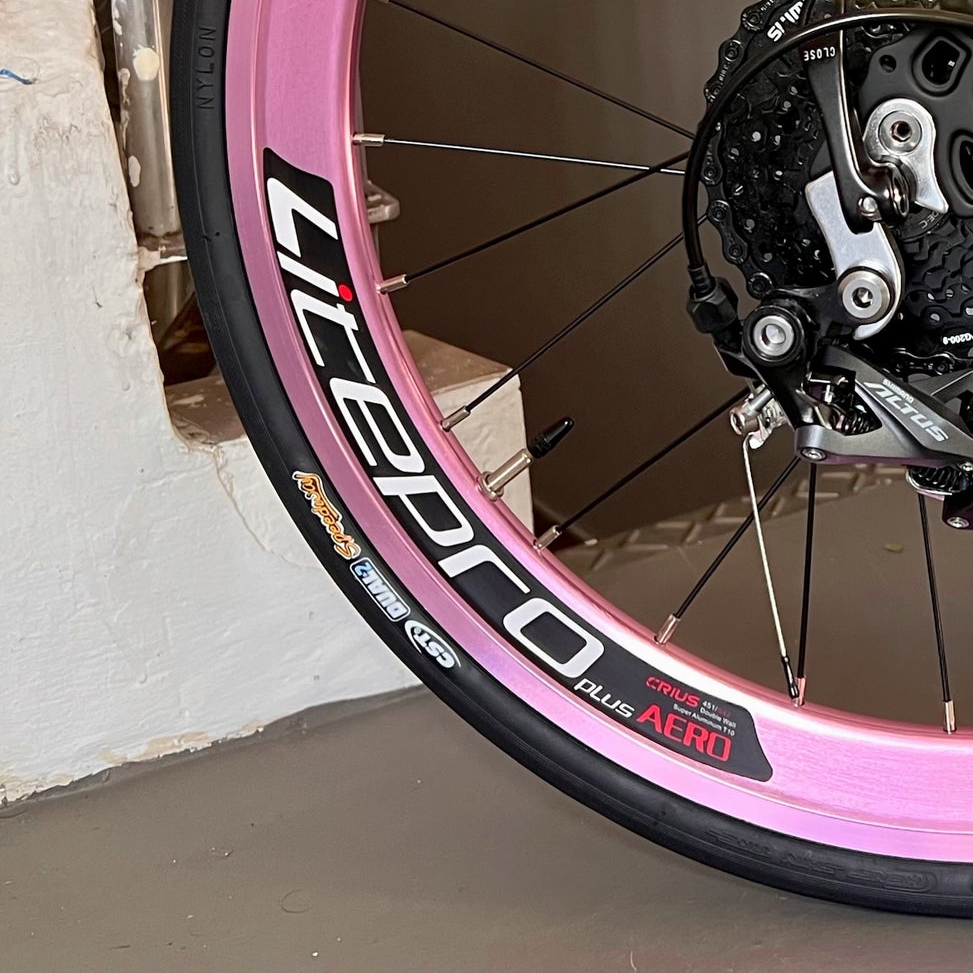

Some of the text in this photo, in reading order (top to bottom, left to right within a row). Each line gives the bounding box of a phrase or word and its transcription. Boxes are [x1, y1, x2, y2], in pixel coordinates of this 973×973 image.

[197, 26, 216, 110] NYLON
[803, 46, 836, 62] CLOSE
[266, 176, 605, 679] Litepro
[863, 381, 949, 442] ALTUS
[292, 470, 362, 560] Speedway
[645, 676, 700, 708] CRIUS
[636, 702, 732, 762] AERO
